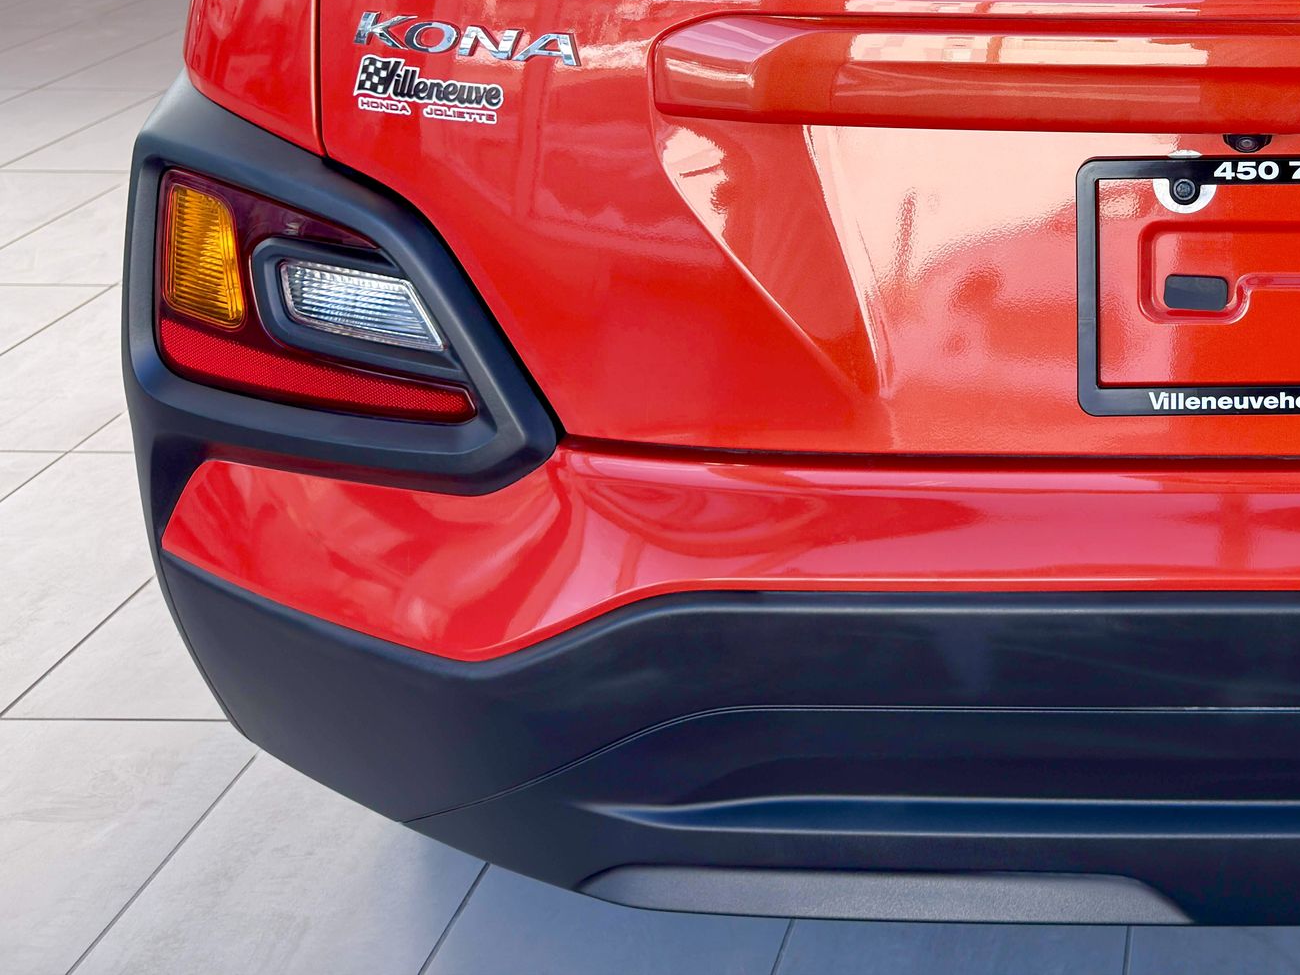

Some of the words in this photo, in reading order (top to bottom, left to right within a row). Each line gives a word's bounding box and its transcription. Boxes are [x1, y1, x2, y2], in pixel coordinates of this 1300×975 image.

[354, 11, 581, 66] KONA
[357, 56, 502, 107] Villeneuve
[360, 99, 410, 114] HONDA
[425, 108, 496, 123] JOLIETTE
[1213, 161, 1279, 180] 450
